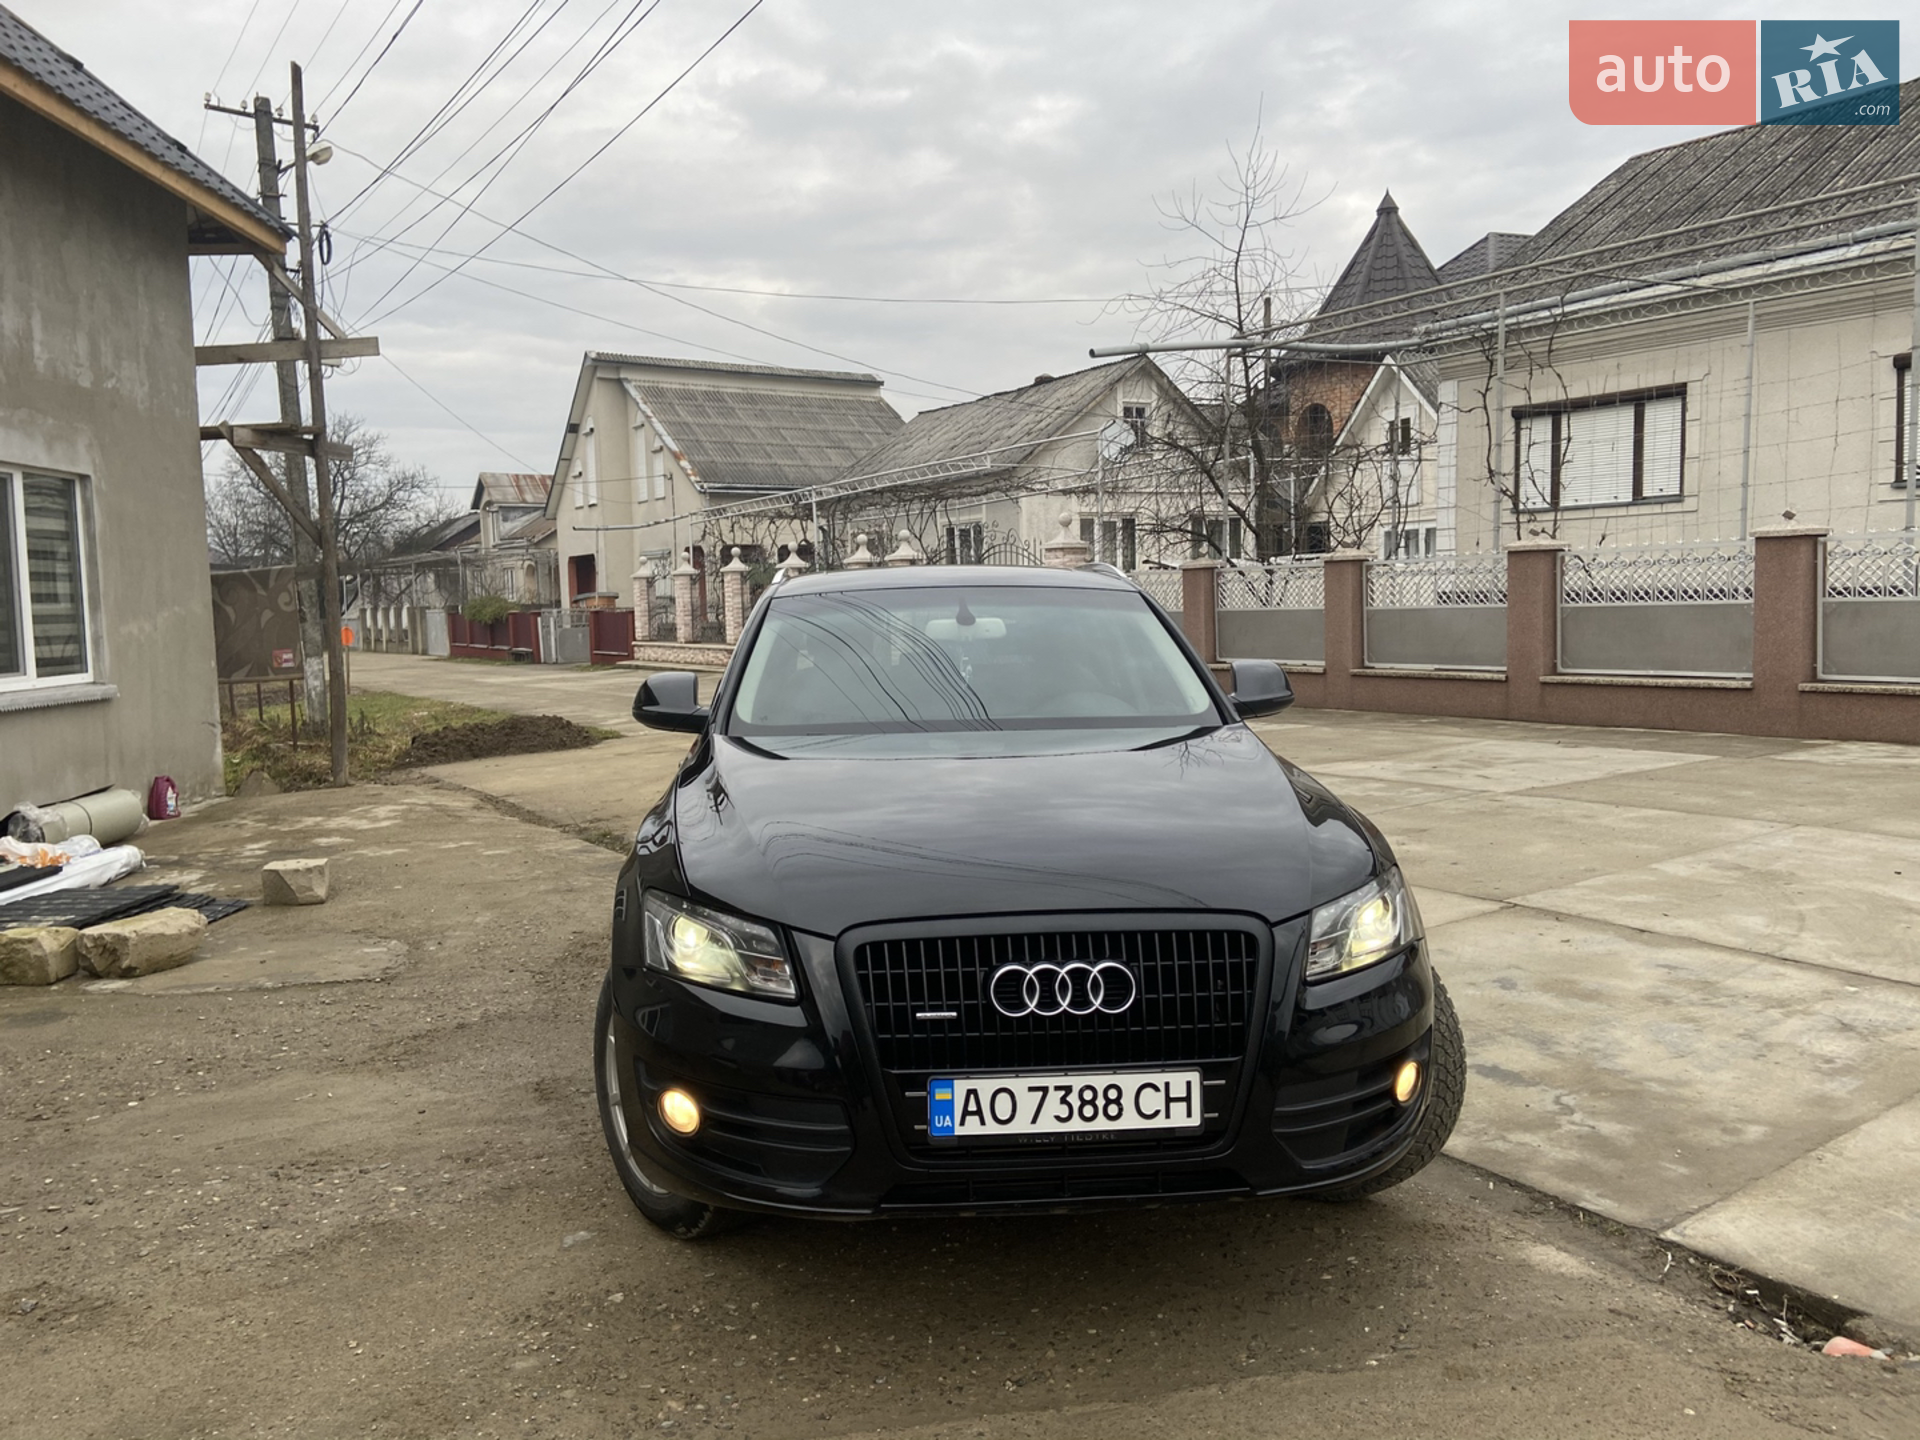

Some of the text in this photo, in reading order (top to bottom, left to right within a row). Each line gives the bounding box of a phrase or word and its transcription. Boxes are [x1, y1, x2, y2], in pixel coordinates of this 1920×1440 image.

[959, 1080, 1193, 1127] AO 7388 CH
[934, 1115, 953, 1128] UA
